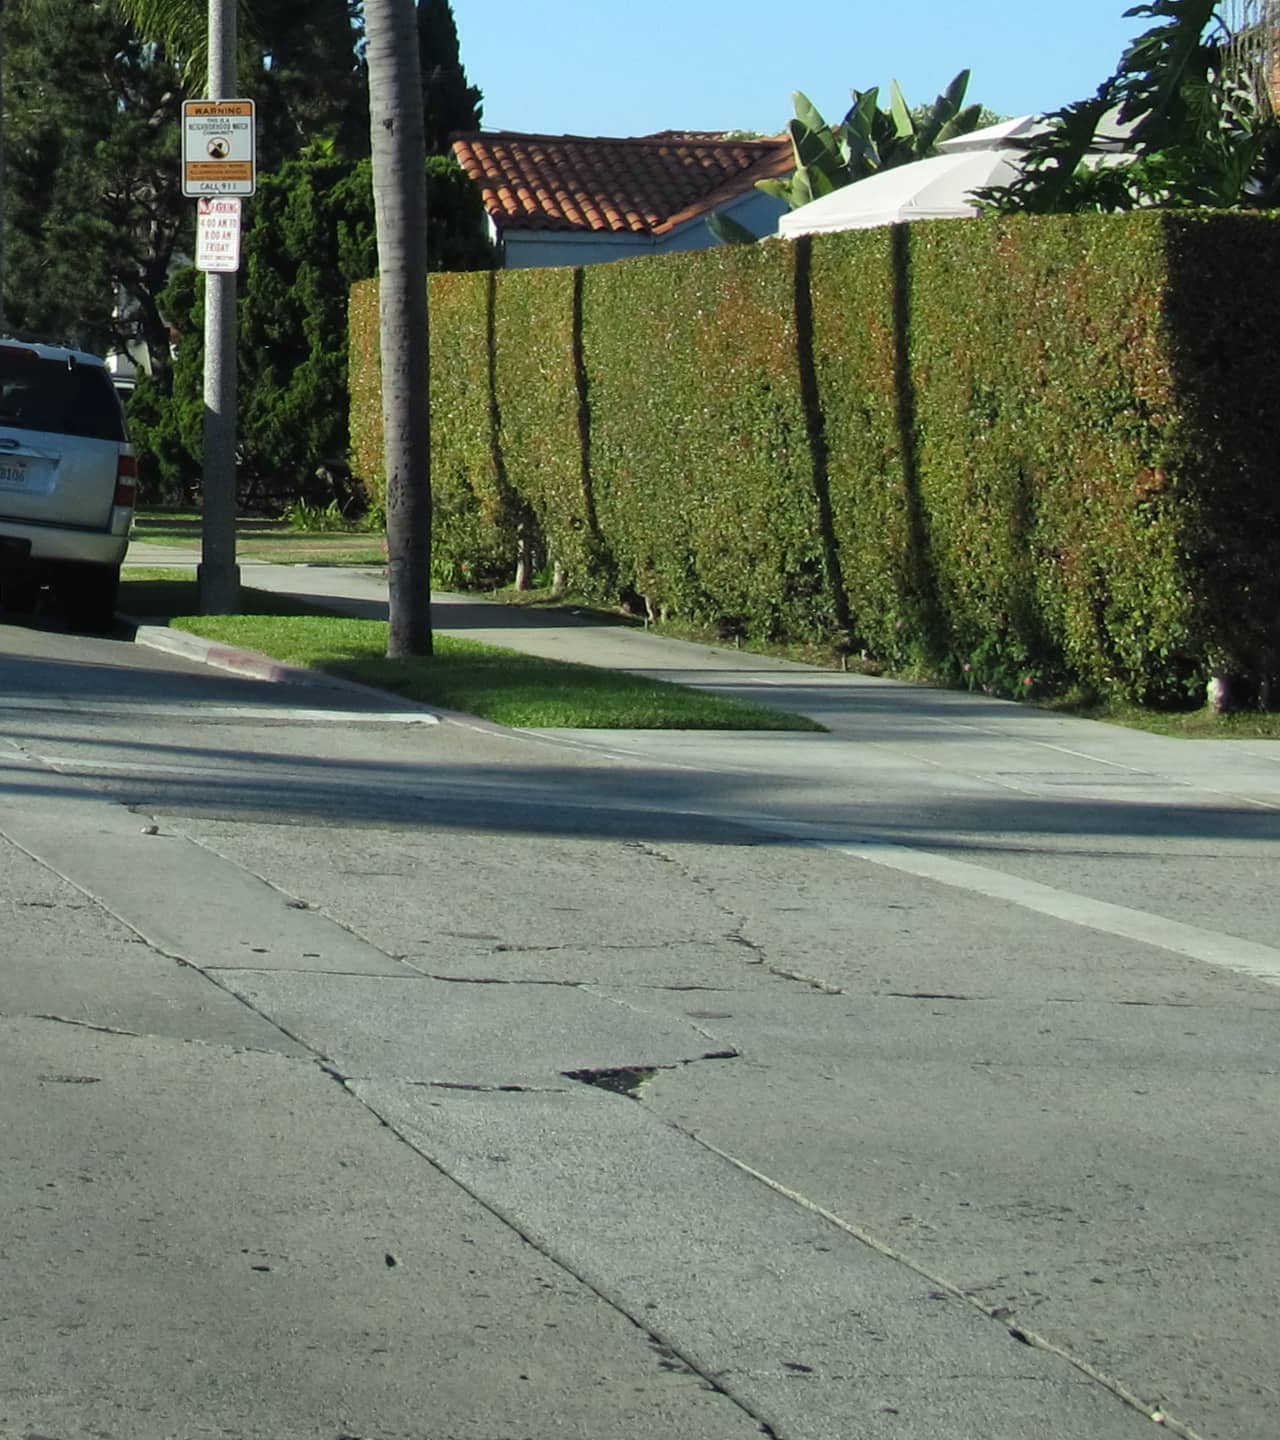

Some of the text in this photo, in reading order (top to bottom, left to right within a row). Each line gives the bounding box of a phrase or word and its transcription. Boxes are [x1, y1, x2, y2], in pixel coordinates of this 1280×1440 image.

[222, 182, 237, 190] 911
[217, 218, 228, 228] AM
[221, 230, 232, 240] AM
[206, 243, 230, 252] FRIDAY
